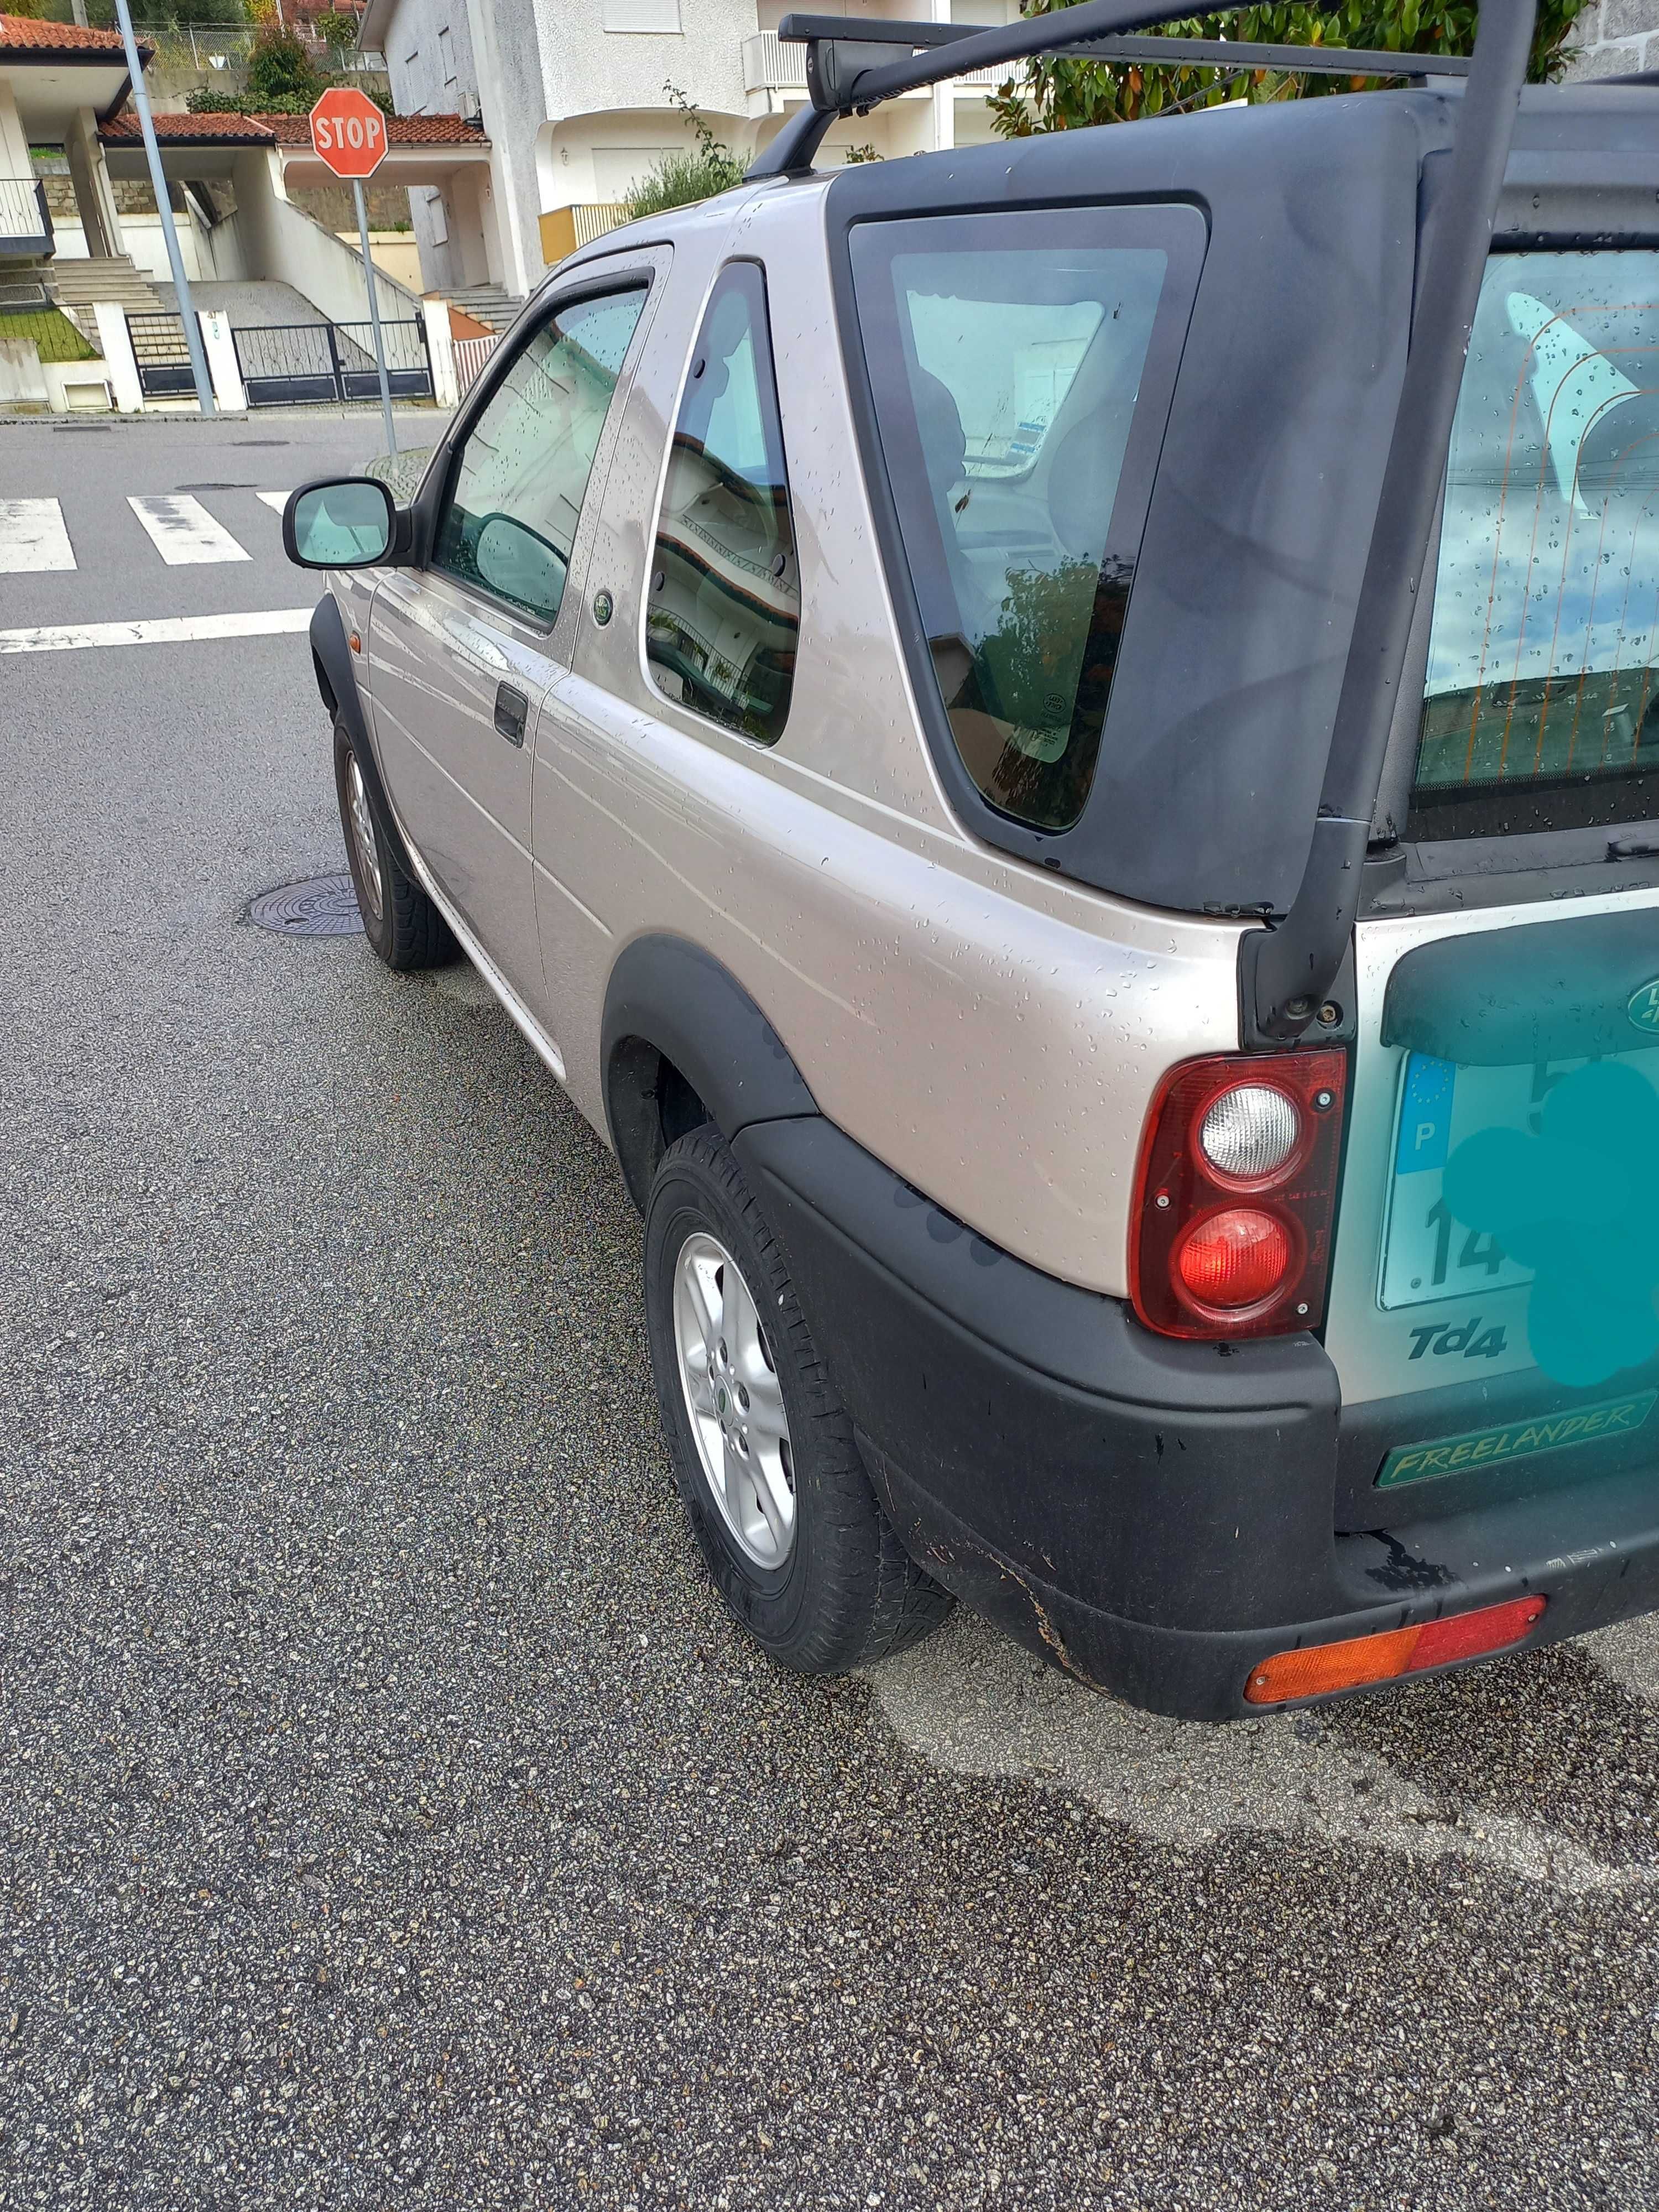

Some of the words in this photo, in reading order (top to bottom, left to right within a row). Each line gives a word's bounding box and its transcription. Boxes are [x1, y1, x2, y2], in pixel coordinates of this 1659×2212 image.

[316, 117, 380, 149] STOP
[1415, 1121, 1436, 1151] P
[1408, 1317, 1508, 1360] Td4
[1390, 1404, 1636, 1478] FREELANDER
